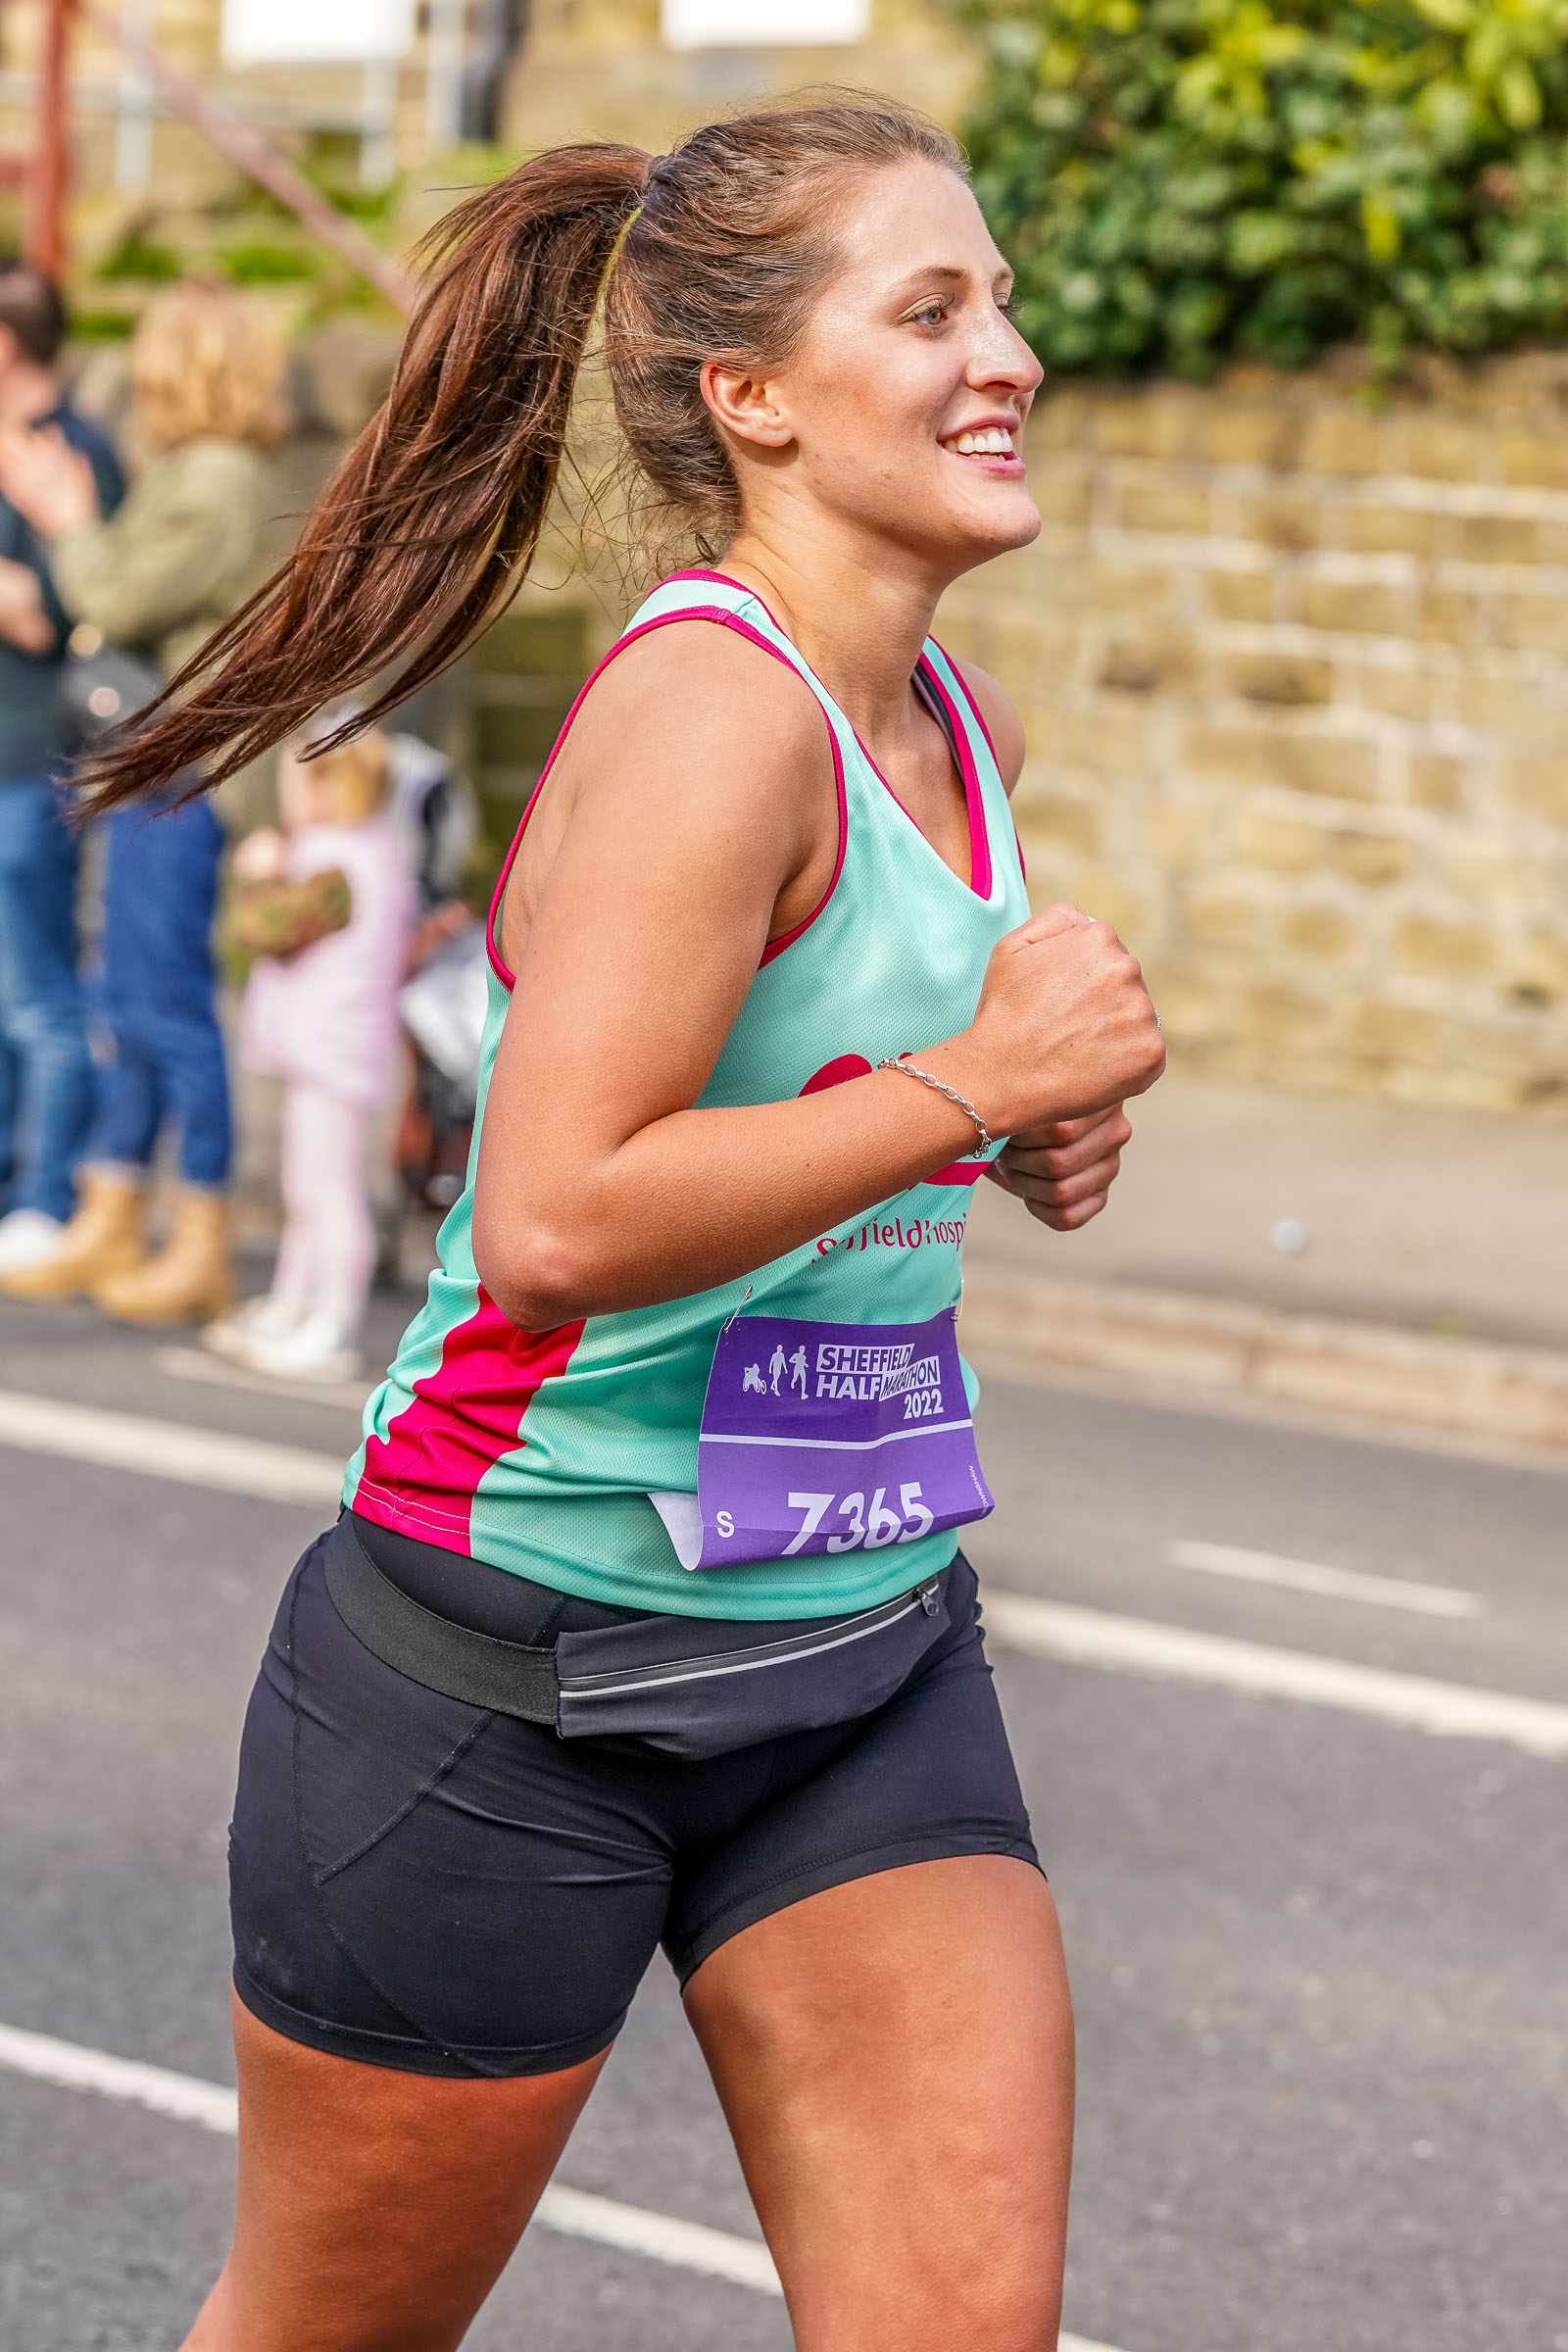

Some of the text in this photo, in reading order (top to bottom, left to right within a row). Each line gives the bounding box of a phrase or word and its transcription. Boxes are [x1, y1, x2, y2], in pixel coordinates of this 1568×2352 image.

[819, 1347, 911, 1372] SHEFFIELD
[815, 1358, 939, 1400] HALF MARATHON
[903, 1388, 945, 1420] 2022
[715, 1510, 735, 1539] S
[780, 1481, 935, 1555] 7365
